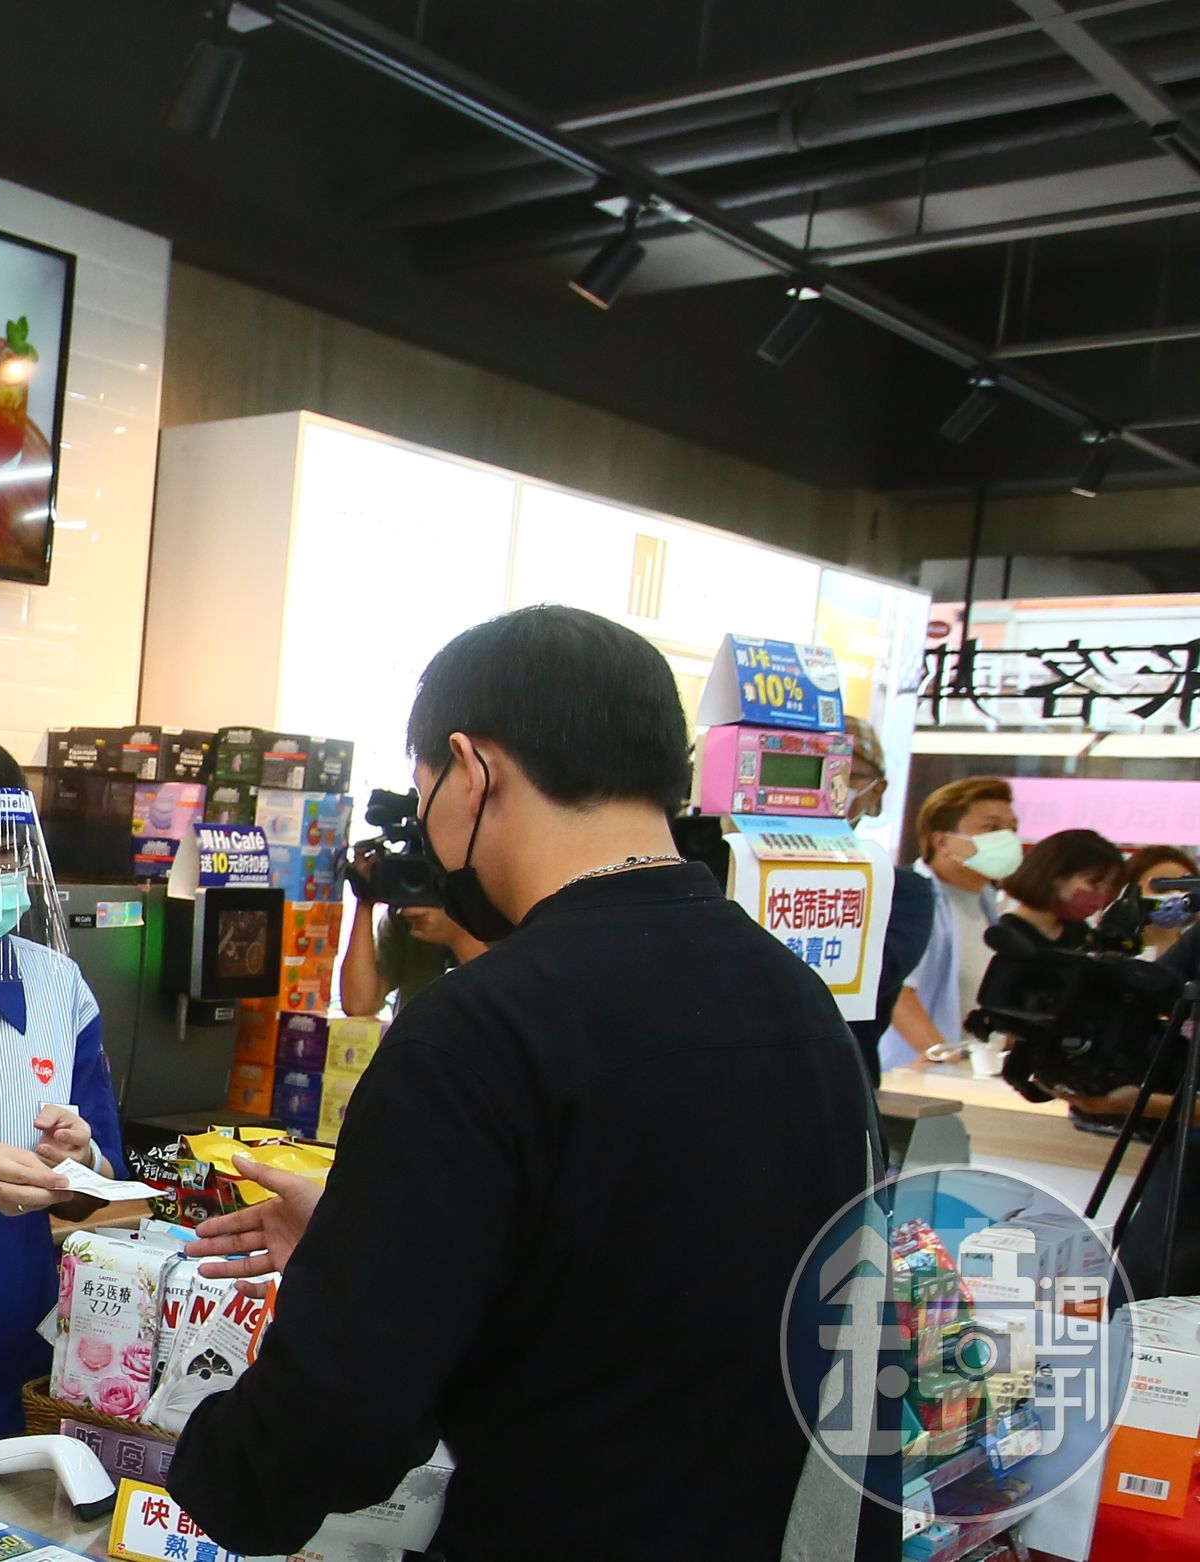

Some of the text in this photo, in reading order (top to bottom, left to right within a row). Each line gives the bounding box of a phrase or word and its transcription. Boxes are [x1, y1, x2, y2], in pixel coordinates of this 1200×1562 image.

[230, 830, 265, 851] Café
[767, 887, 866, 931] 快篩試劑
[81, 1279, 132, 1304] 香る医療
[89, 1299, 122, 1318] マスク
[1130, 1351, 1163, 1364] FORA
